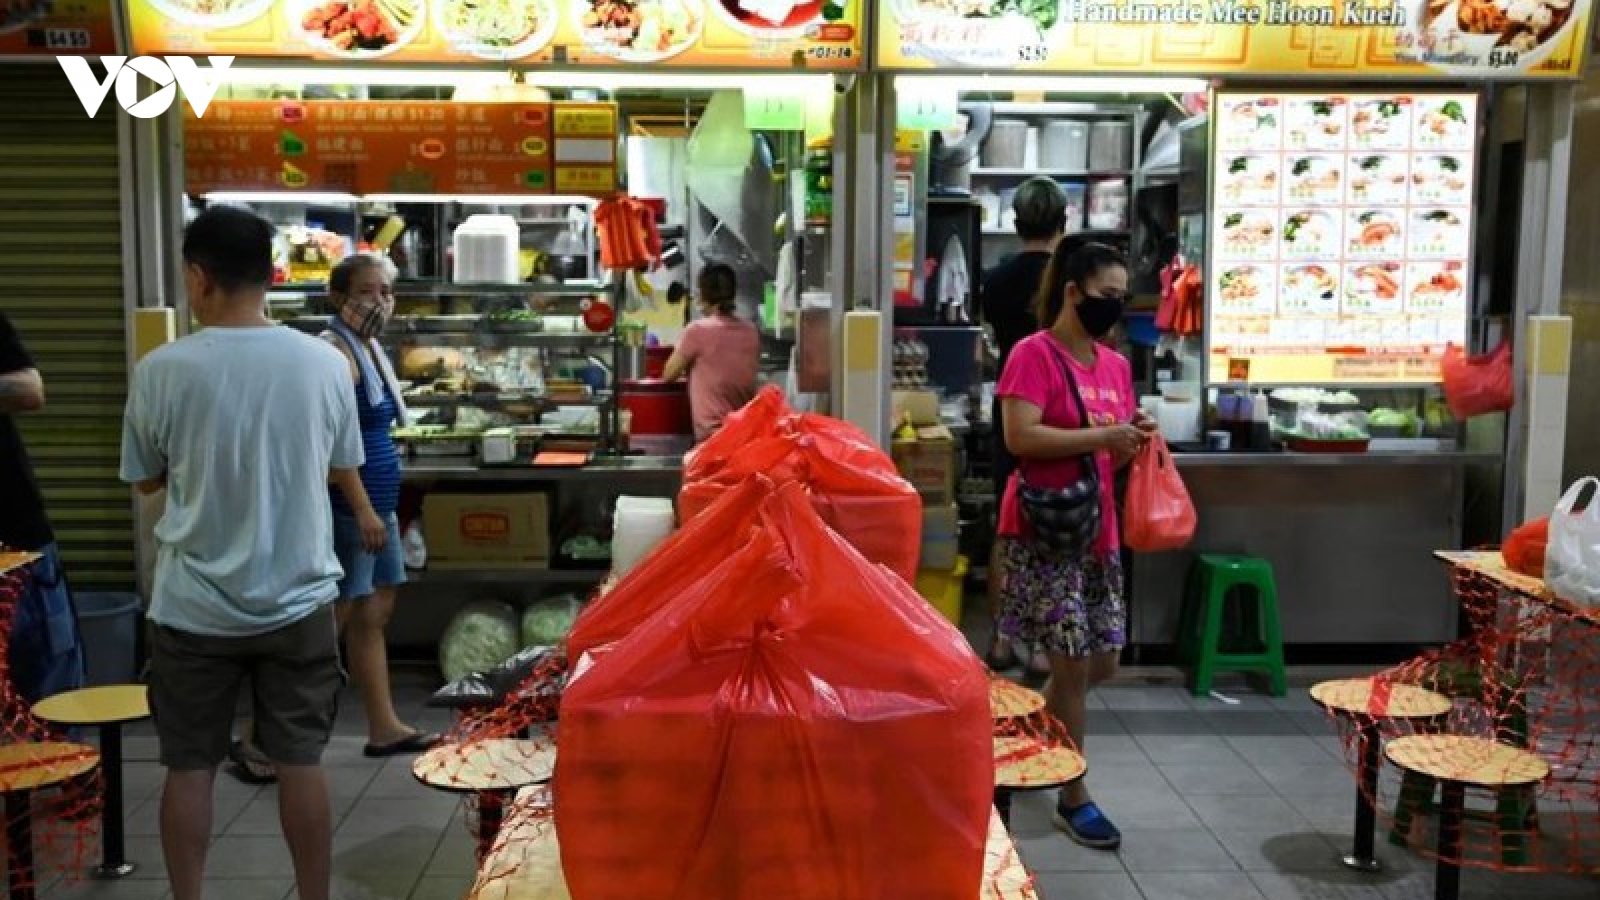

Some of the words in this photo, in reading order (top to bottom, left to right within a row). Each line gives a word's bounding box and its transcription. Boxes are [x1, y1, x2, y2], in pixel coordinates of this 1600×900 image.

[1065, 0, 1202, 25] Handmade
[1206, 0, 1261, 26] Mee
[1264, 1, 1336, 26] Hoon
[1342, 3, 1406, 27] Kueh
